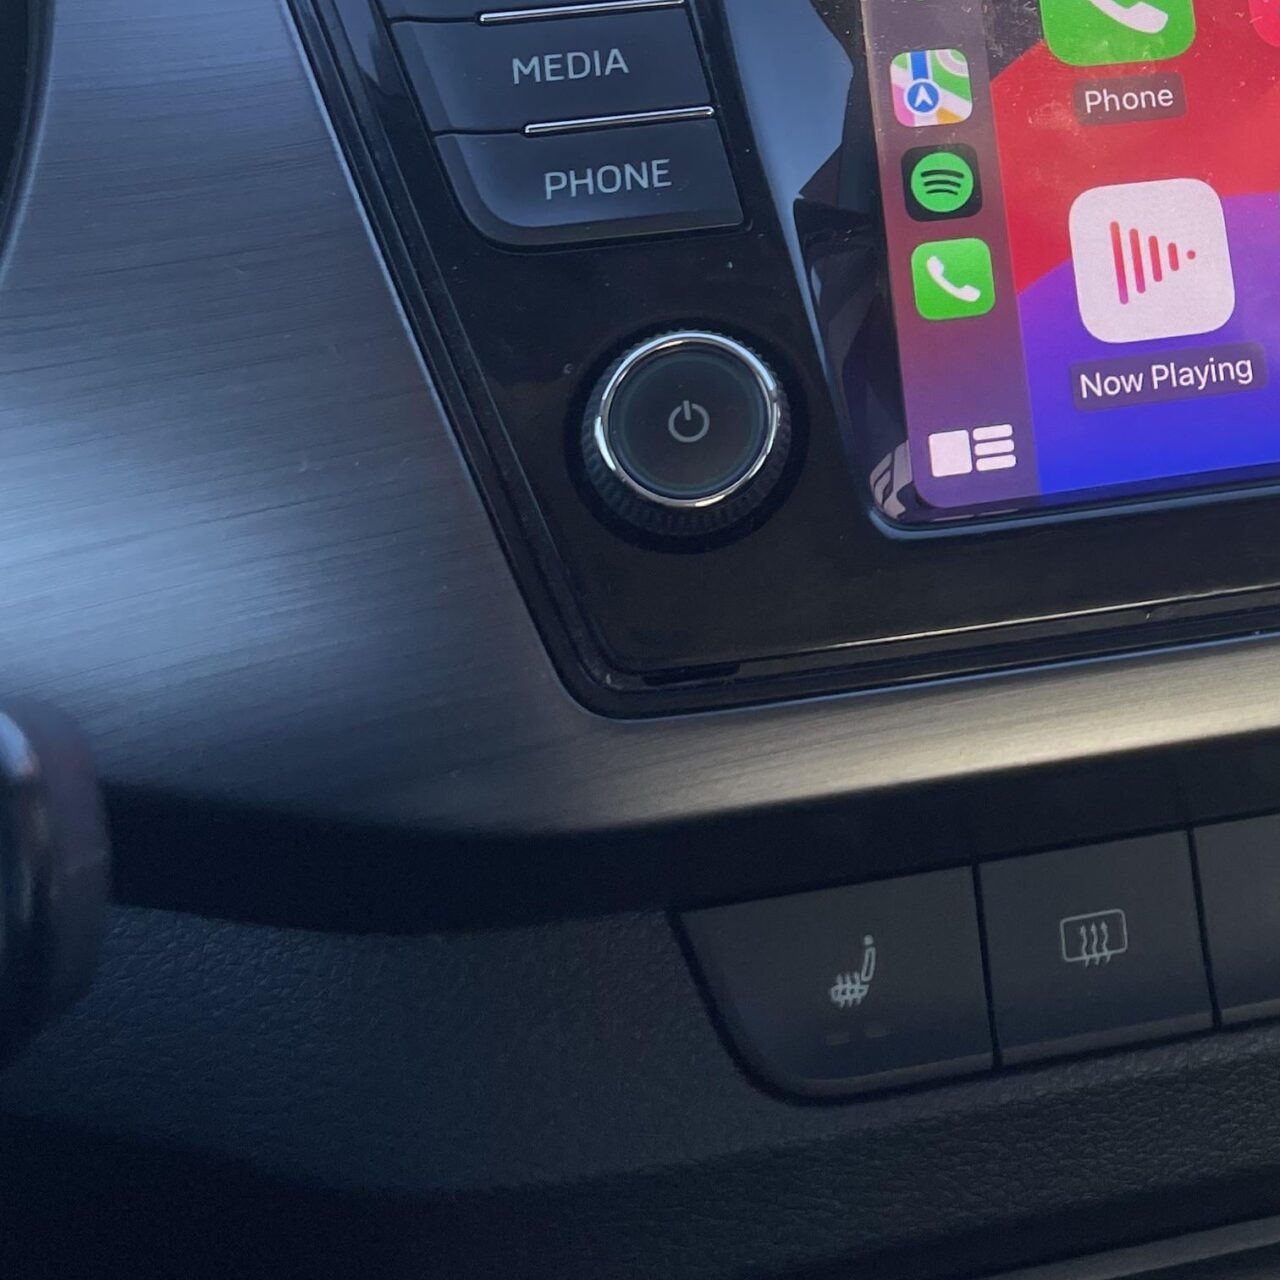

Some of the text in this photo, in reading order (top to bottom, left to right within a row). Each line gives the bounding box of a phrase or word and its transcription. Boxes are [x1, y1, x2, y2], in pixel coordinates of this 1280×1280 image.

[511, 47, 630, 85] MEDIA
[1083, 82, 1175, 114] Phone
[543, 158, 673, 201] PHONE
[1079, 356, 1255, 399] Now Playing
